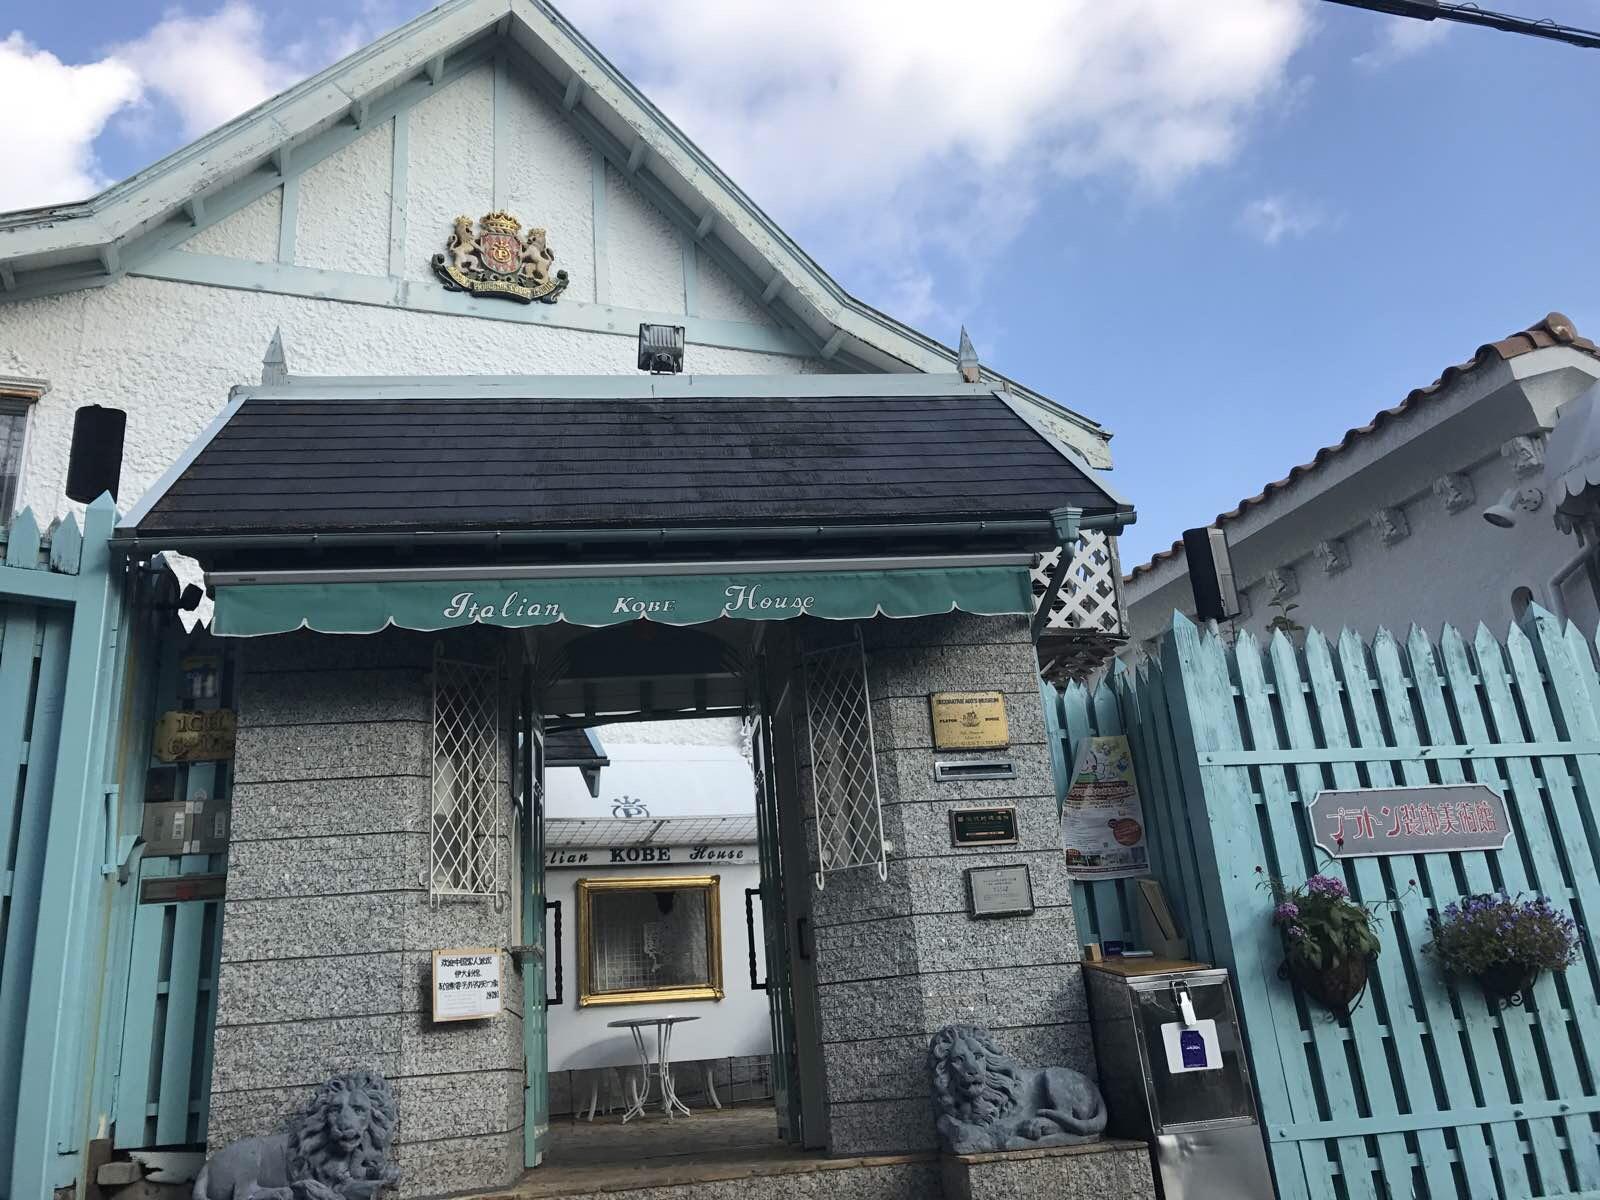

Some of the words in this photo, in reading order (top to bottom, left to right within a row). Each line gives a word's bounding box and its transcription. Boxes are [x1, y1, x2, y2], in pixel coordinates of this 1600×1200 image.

[443, 591, 560, 618] Italian
[724, 584, 815, 612] House
[1326, 799, 1497, 841] プラトン装飾美術館
[544, 850, 589, 865] lian
[610, 847, 671, 863] KOBE
[689, 846, 744, 861] House
